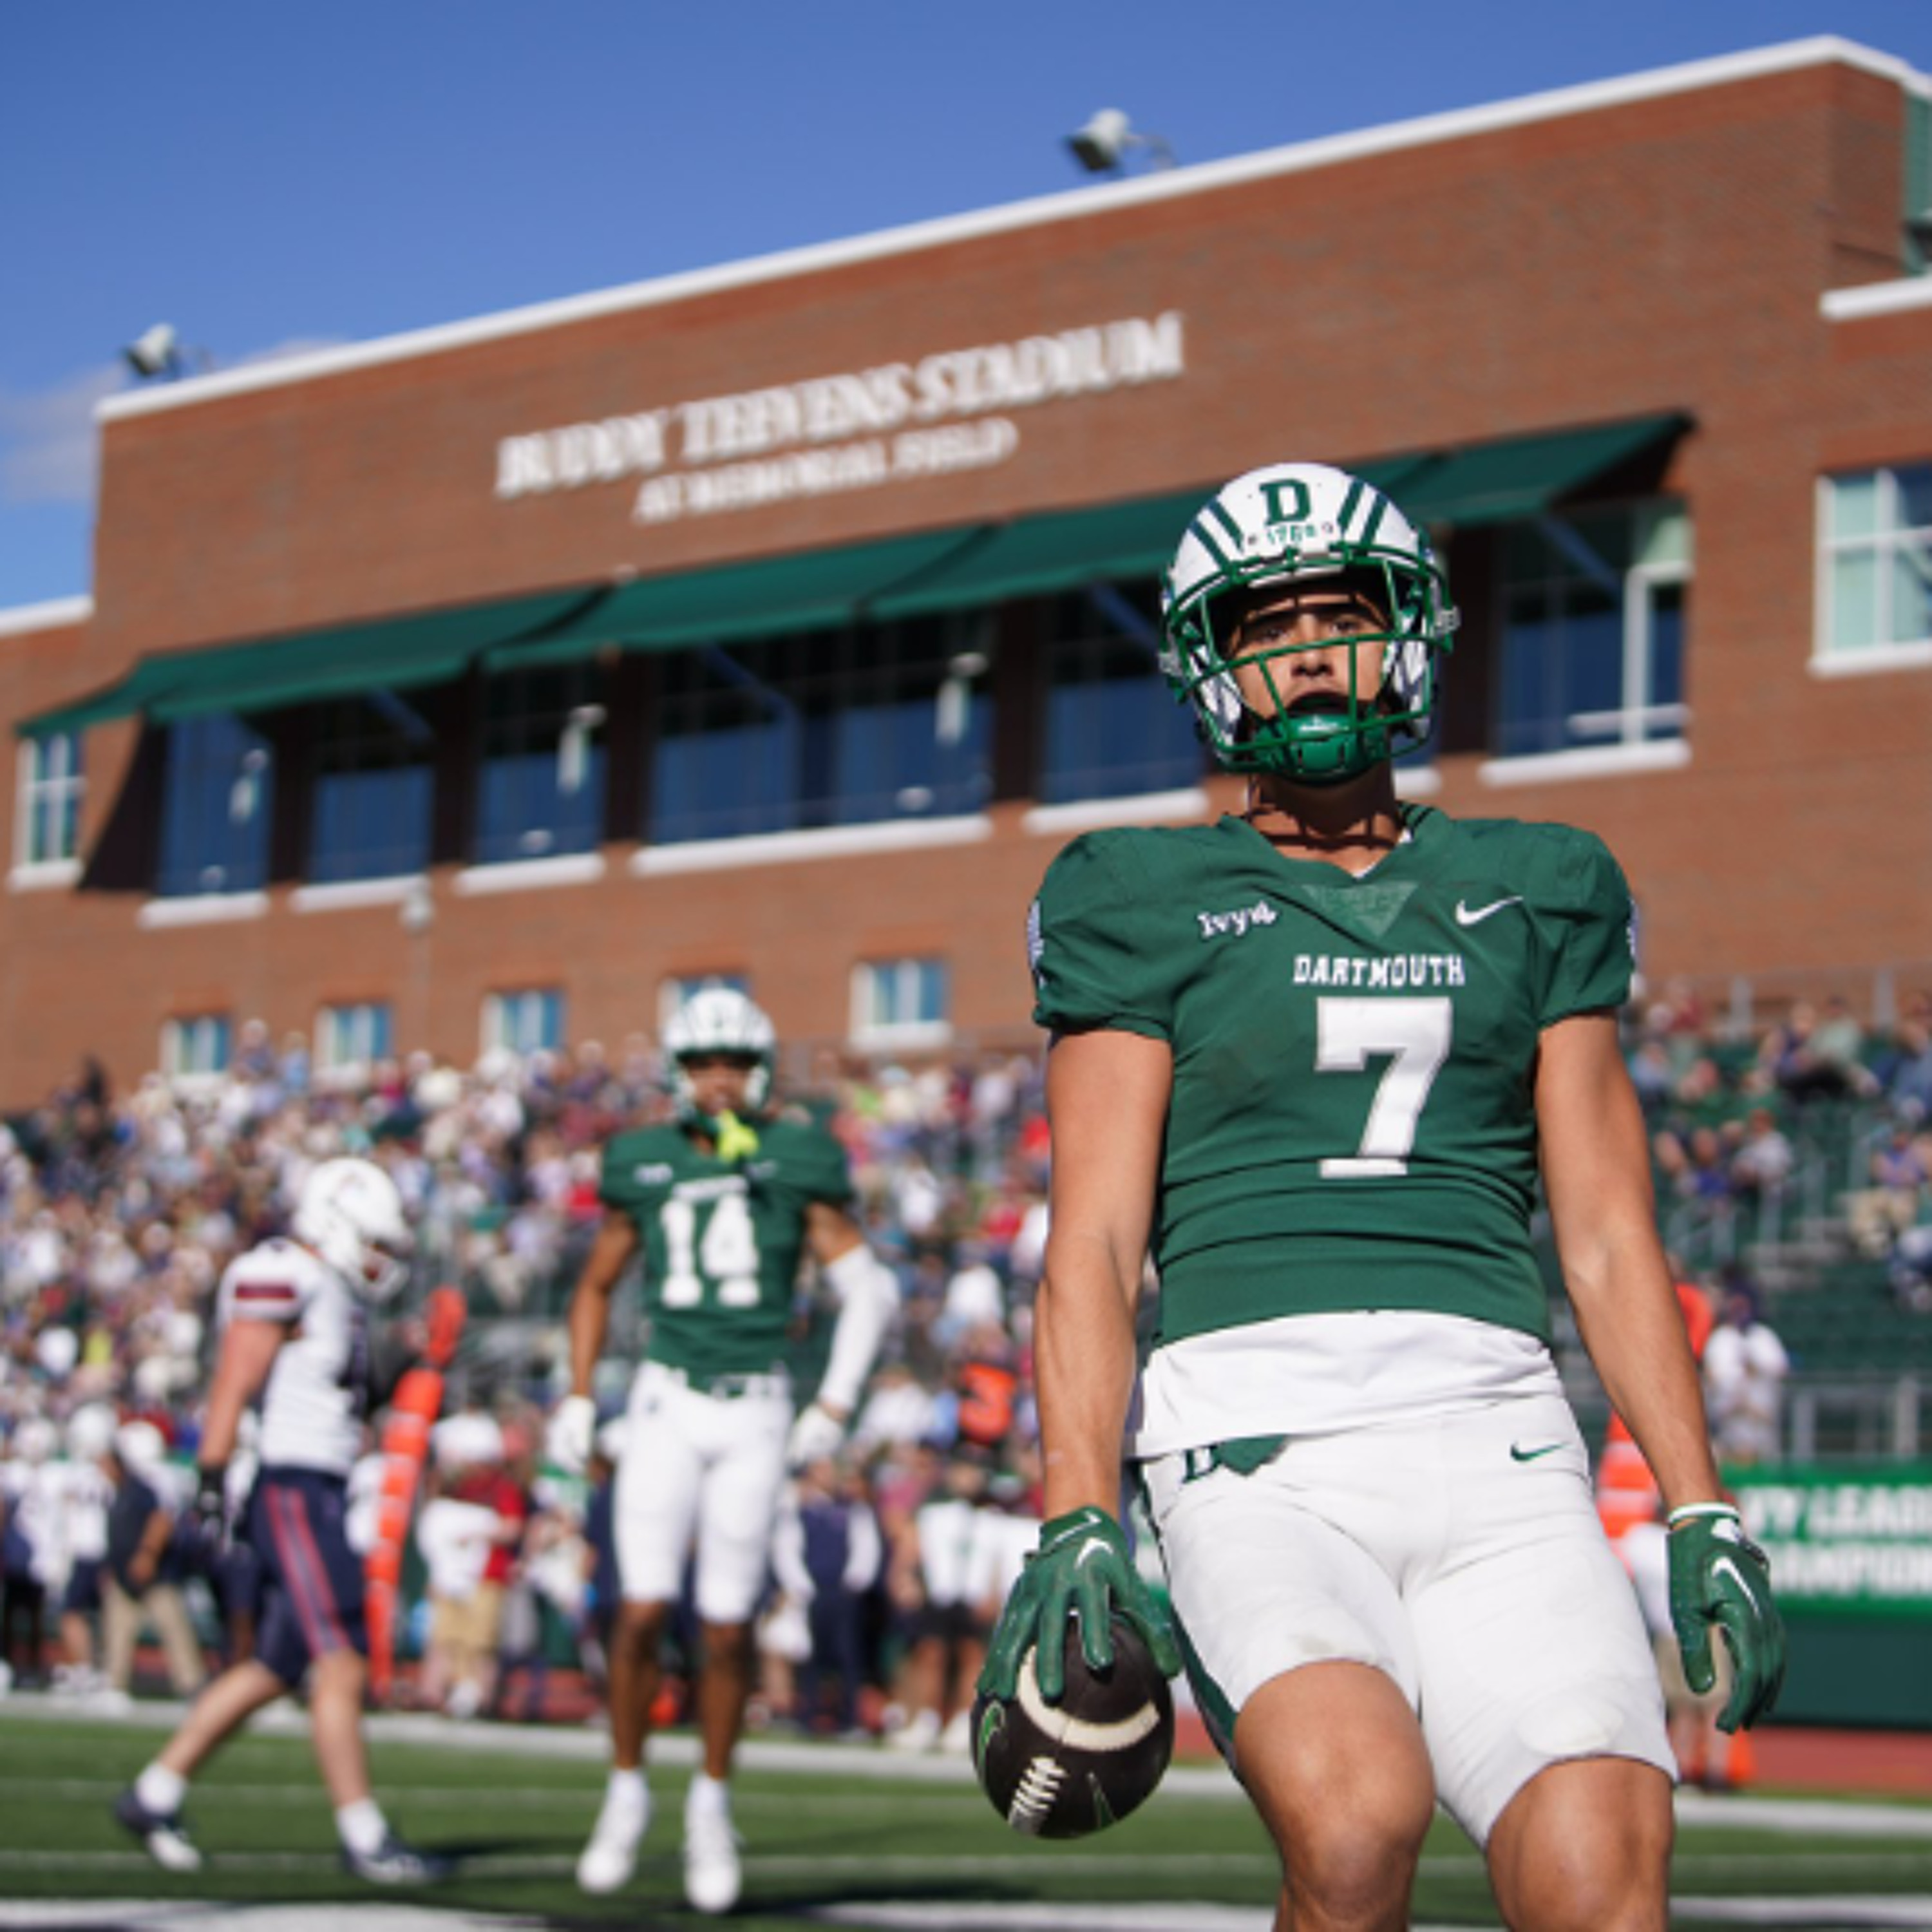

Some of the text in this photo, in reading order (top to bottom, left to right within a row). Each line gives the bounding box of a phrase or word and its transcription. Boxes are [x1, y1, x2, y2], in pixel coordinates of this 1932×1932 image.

[912, 312, 1184, 419] STADIUM
[1258, 478, 1311, 527] D
[1293, 953, 1466, 989] DARTMOUTH
[1314, 996, 1452, 1179] 7
[661, 1193, 761, 1308] 14
